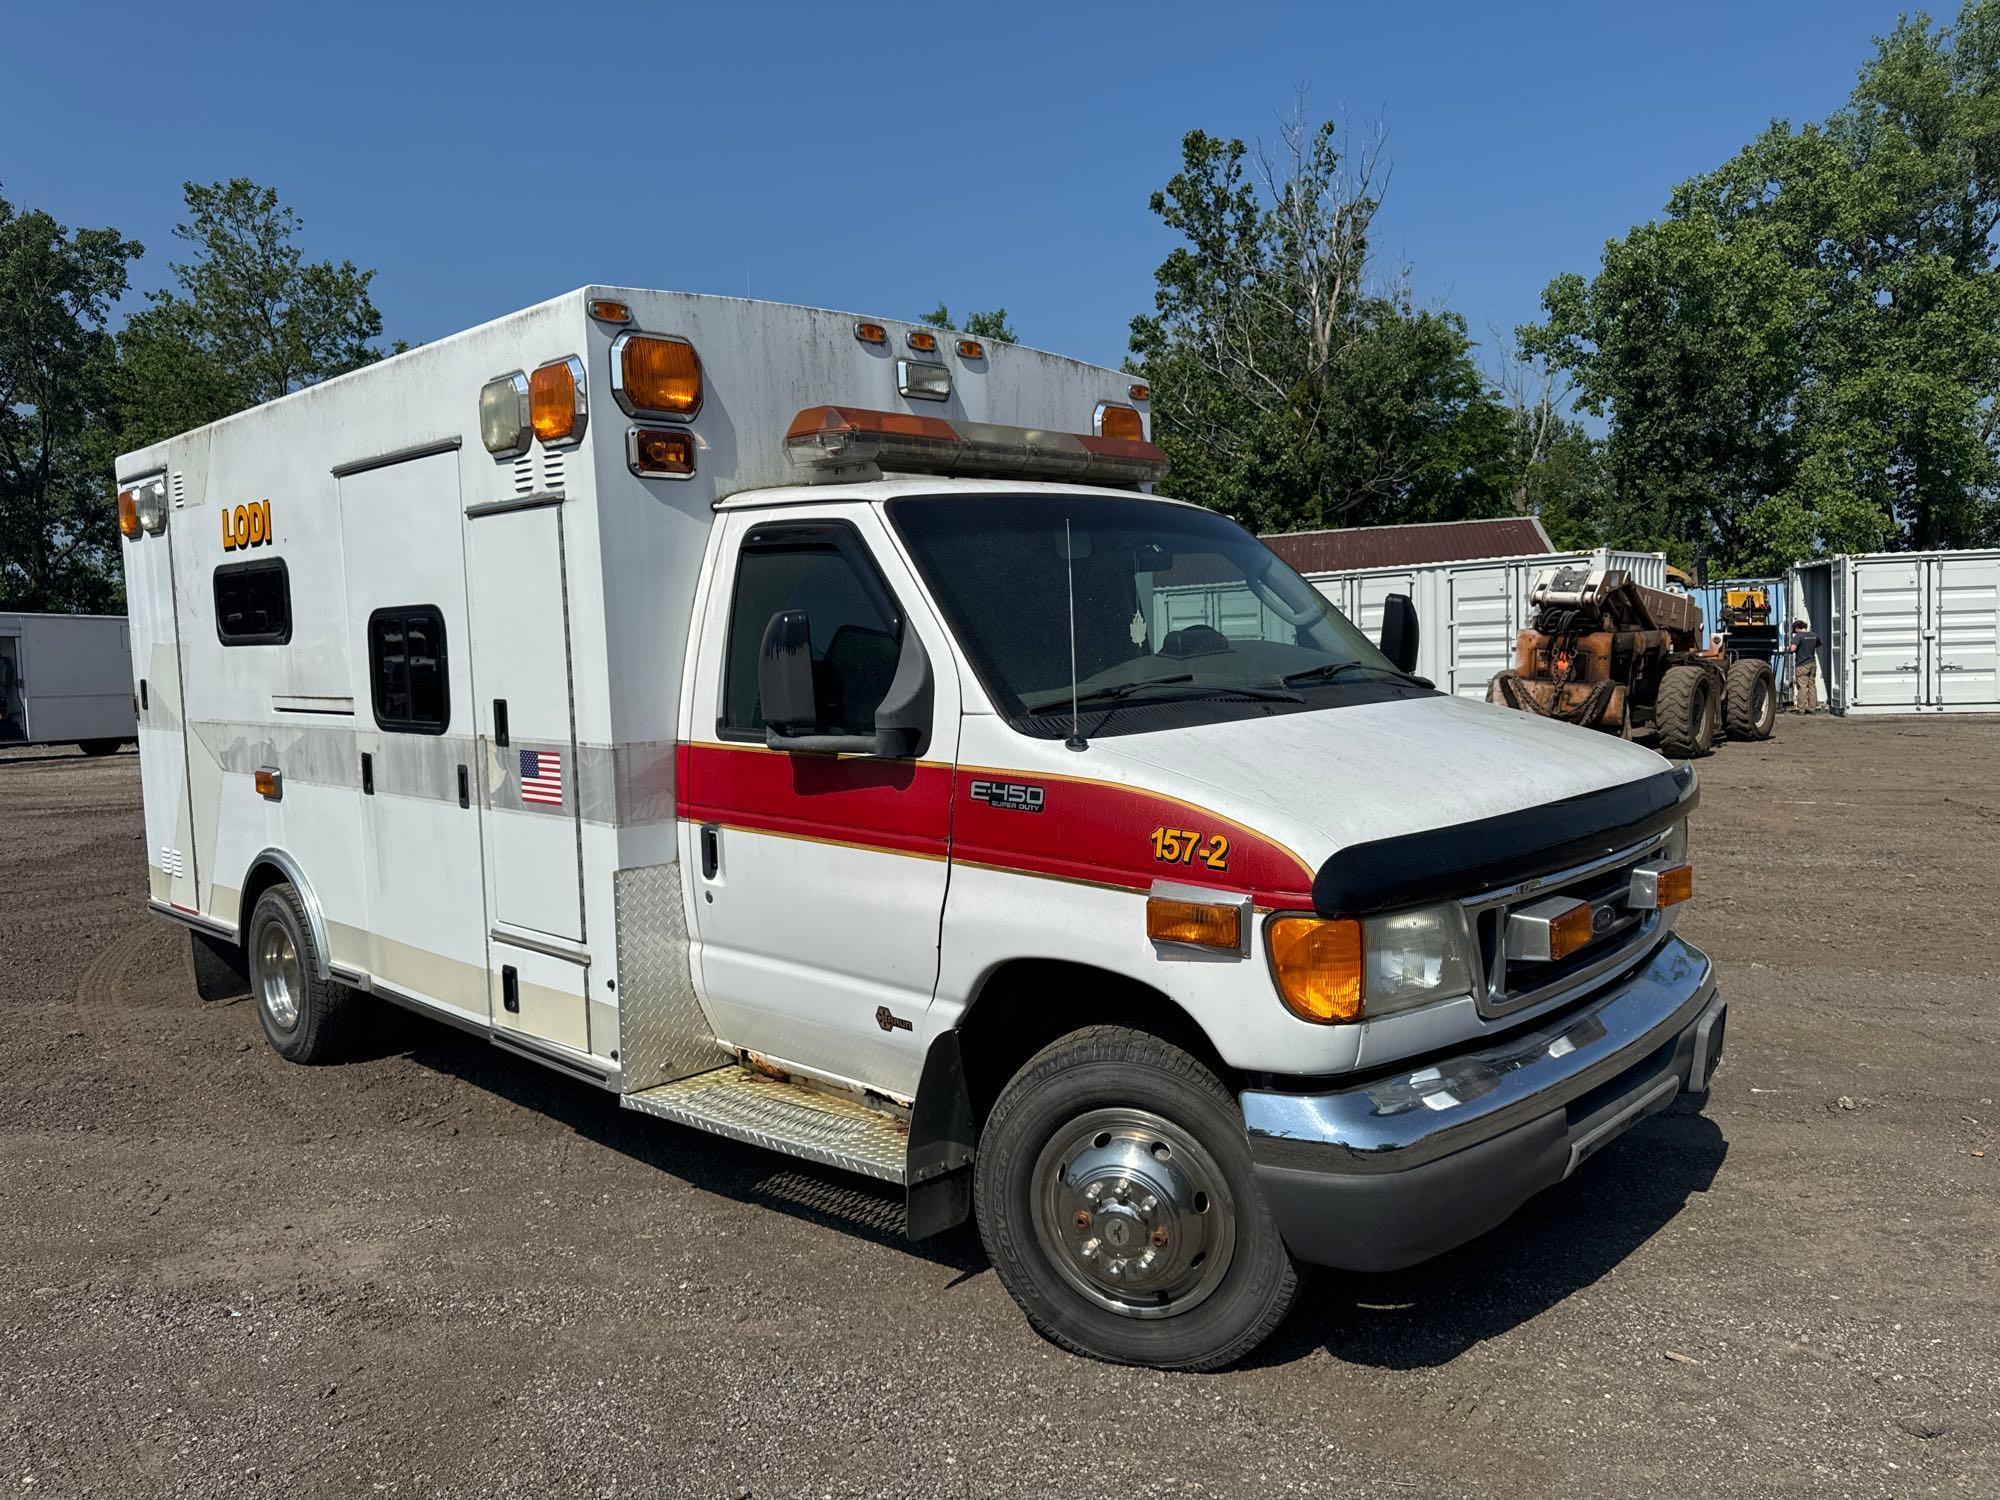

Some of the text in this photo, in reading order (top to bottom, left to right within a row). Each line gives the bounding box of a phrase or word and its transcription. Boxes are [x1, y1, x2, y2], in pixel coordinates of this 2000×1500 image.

[222, 499, 272, 552] LODI
[971, 780, 1044, 805] E-450
[991, 800, 1040, 812] SUPER DUTY
[1151, 827, 1230, 872] 157-2
[882, 1015, 912, 1030] BRAUN
[994, 1151, 1040, 1299] DISCOVERER
